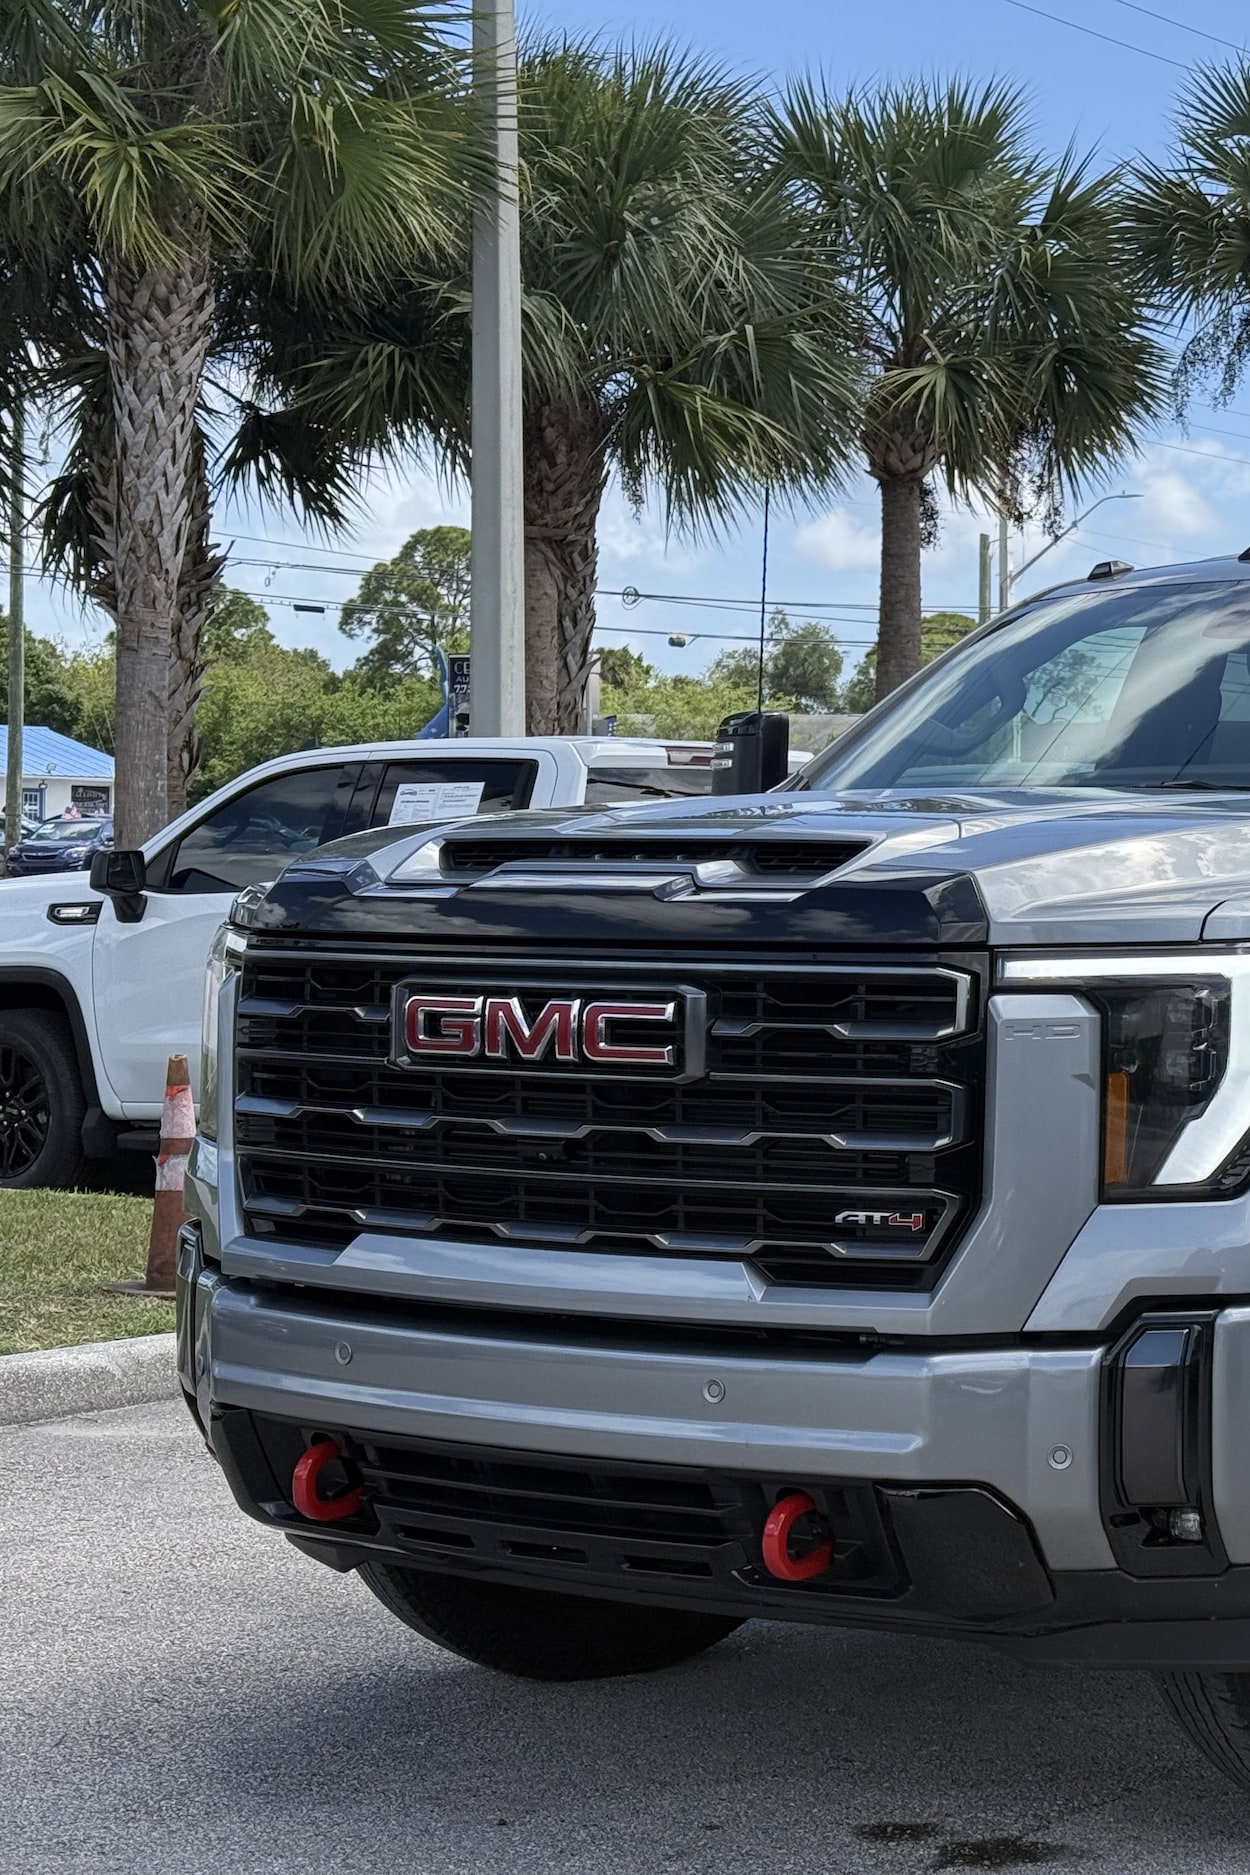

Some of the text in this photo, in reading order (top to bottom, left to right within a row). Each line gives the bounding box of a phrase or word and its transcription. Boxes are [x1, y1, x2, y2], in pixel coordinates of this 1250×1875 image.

[404, 996, 677, 1066] GMC
[1005, 1024, 1081, 1041] HD
[834, 1210, 923, 1232] AT4
